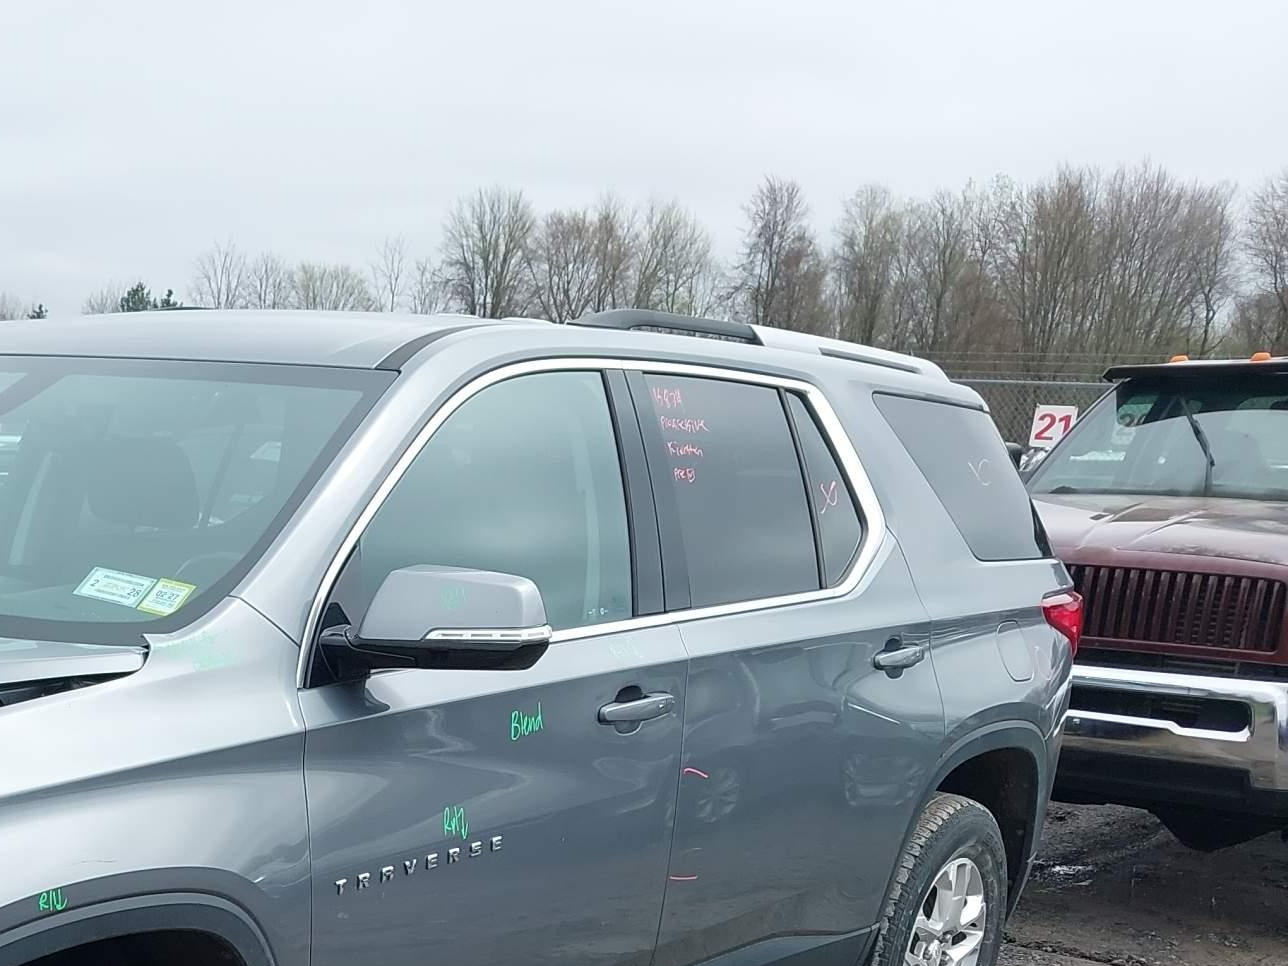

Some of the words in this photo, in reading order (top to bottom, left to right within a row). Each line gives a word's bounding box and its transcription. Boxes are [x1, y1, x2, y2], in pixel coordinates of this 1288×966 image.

[1034, 412, 1073, 441] 21
[90, 578, 100, 588] 2
[511, 700, 544, 741] Blend
[334, 834, 503, 896] TRAVERSE
